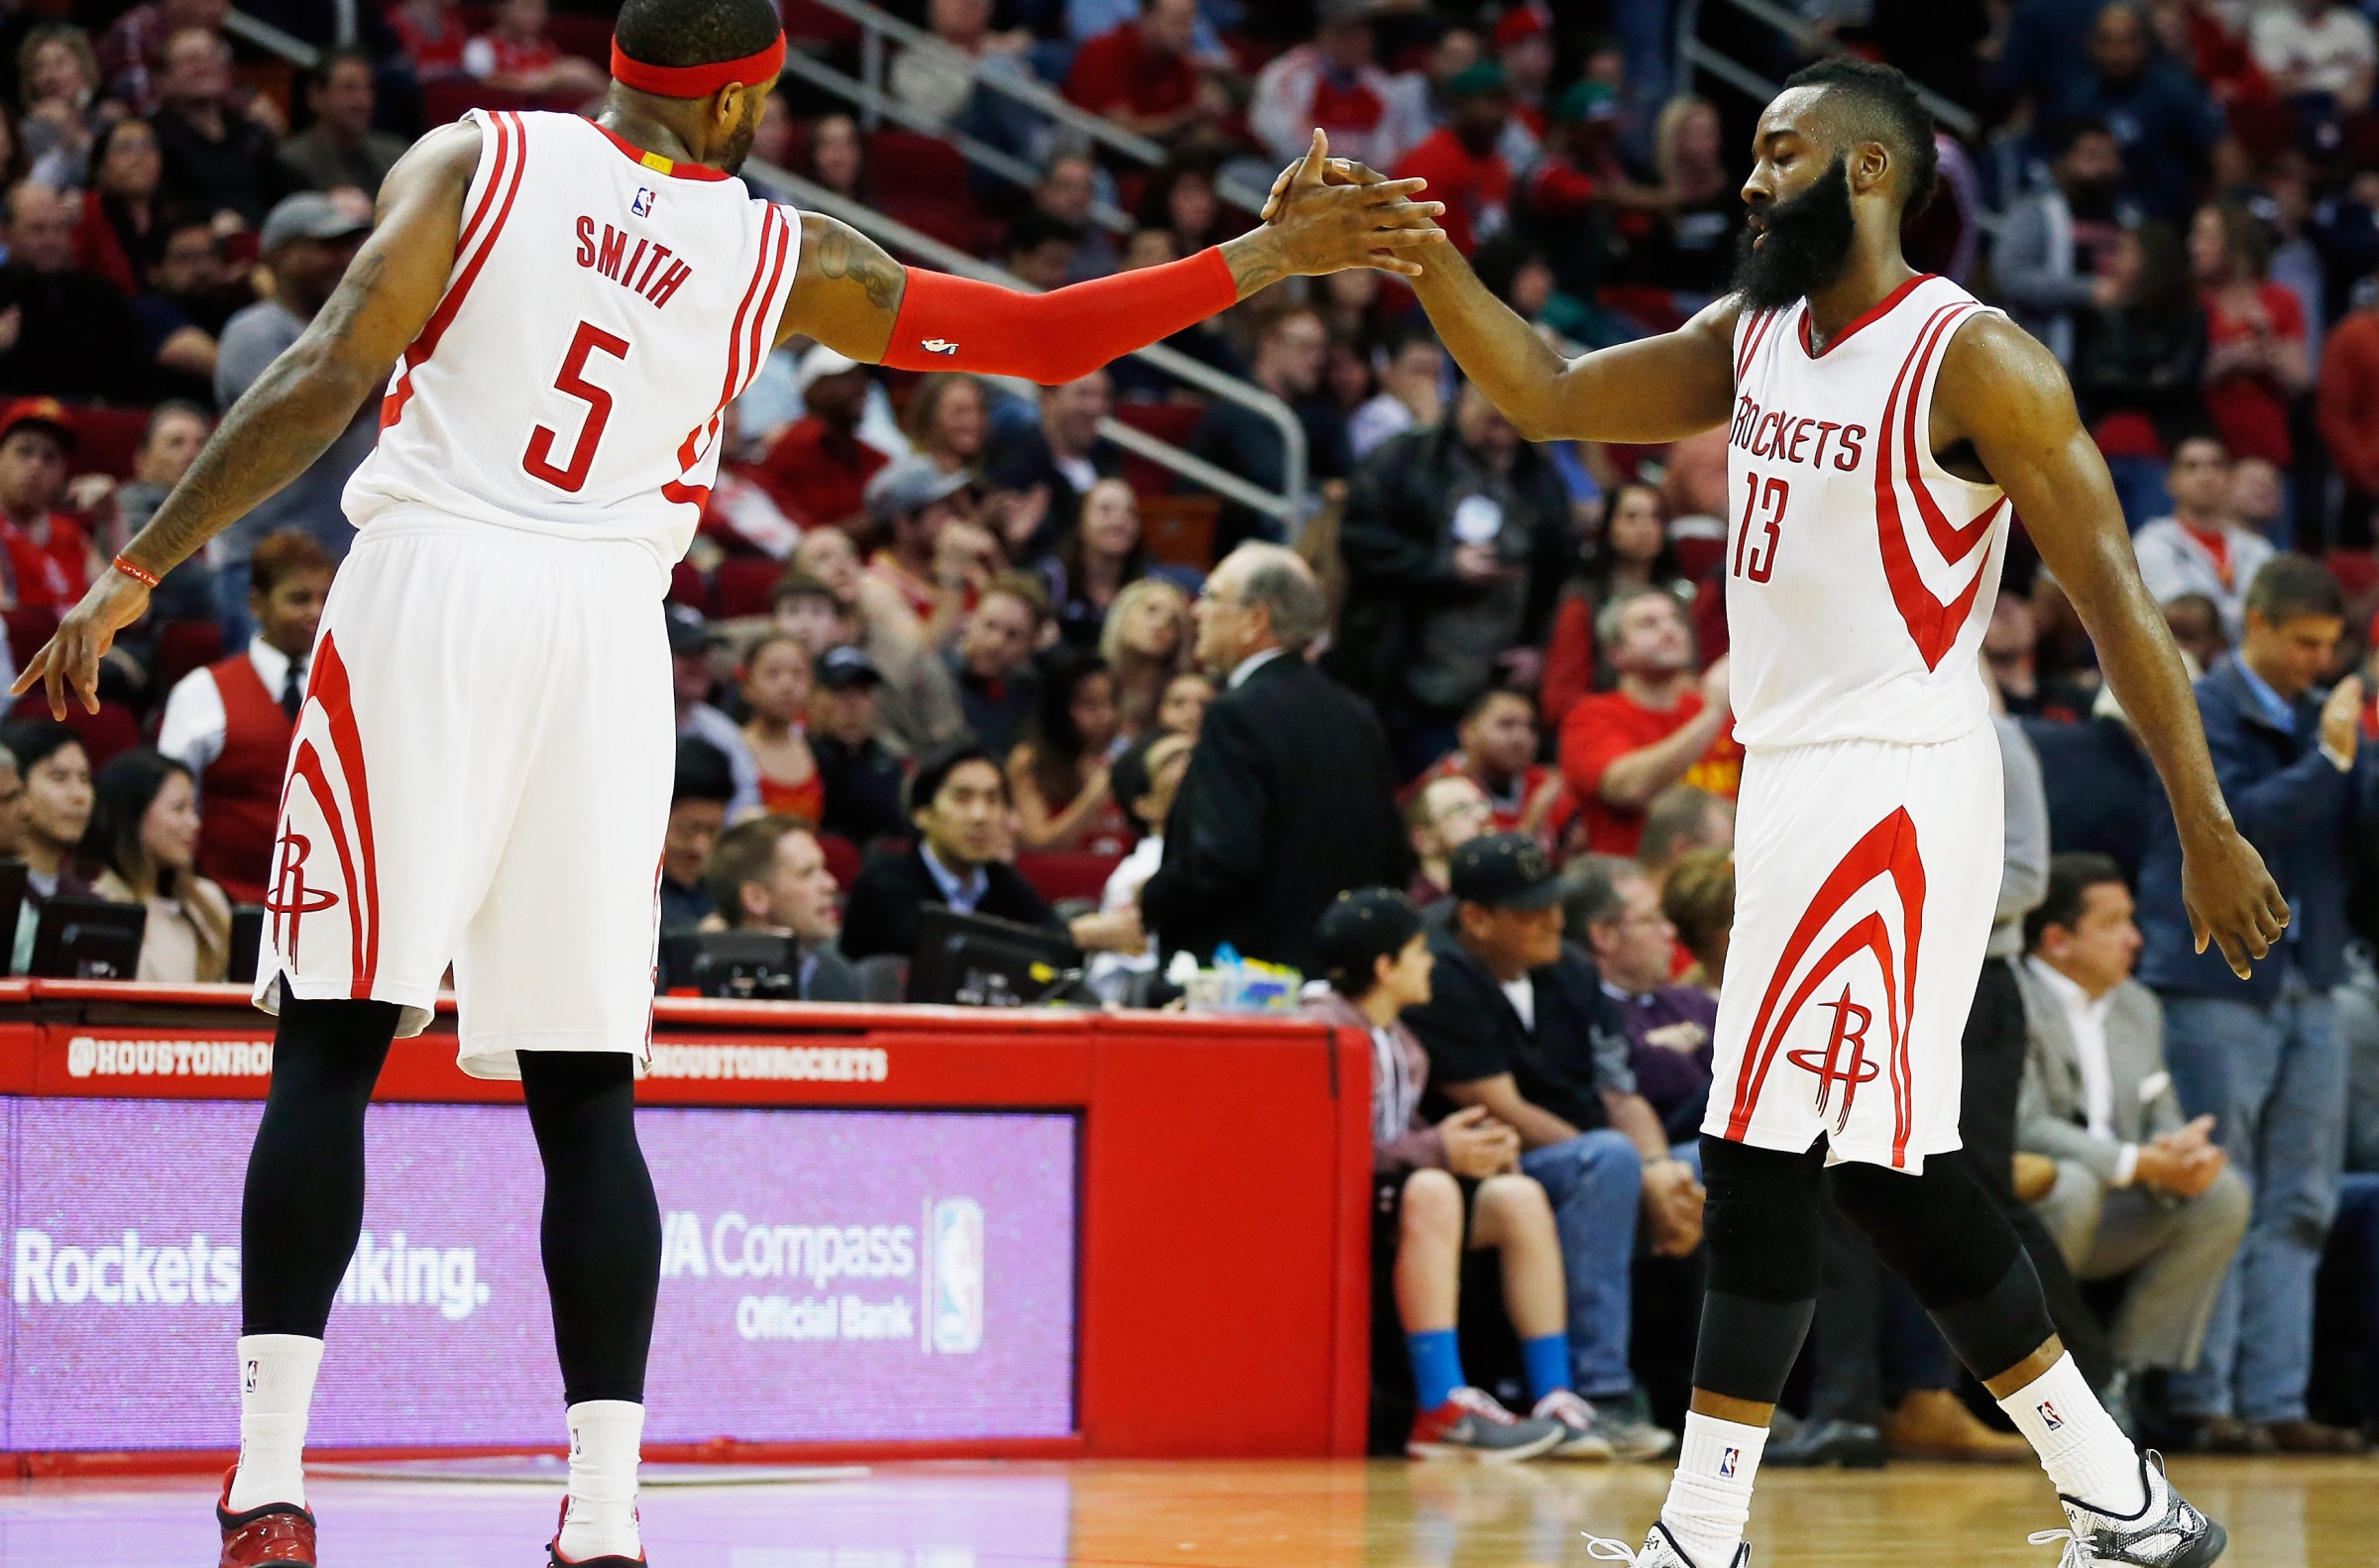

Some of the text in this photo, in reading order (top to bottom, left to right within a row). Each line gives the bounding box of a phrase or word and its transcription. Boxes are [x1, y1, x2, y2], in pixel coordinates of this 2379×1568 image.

[576, 215, 692, 309] SMITH
[522, 320, 630, 493] 5
[1729, 388, 1867, 472] ROCKETS
[1734, 471, 1789, 584] 13
[67, 1037, 888, 1082] @HOUSTONRO HOUSTONROCKETS
[14, 1228, 242, 1304] Rockets
[712, 1211, 915, 1289] Compass
[736, 1294, 839, 1340] Official
[842, 1294, 914, 1340] Bank
